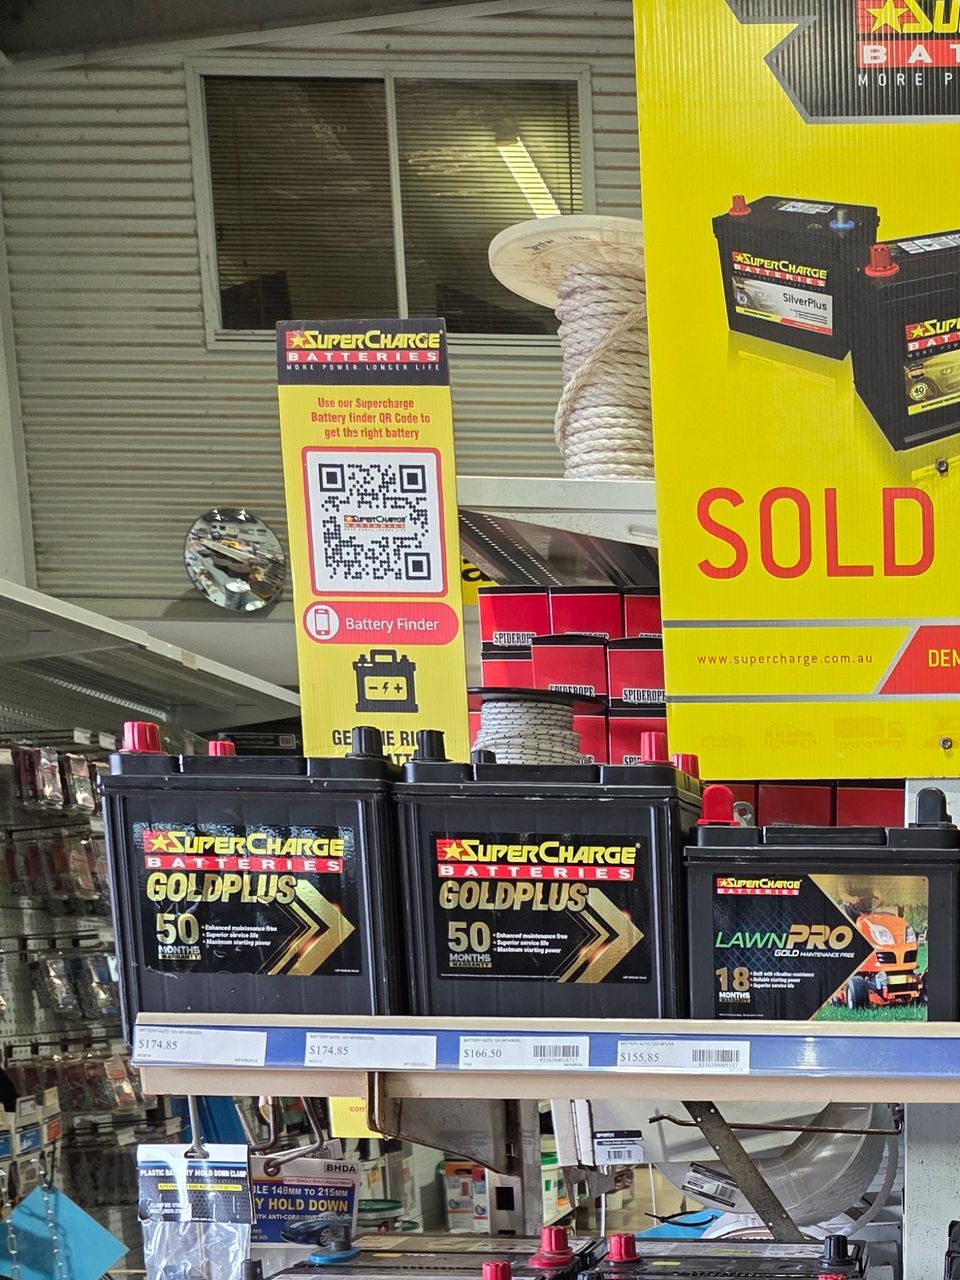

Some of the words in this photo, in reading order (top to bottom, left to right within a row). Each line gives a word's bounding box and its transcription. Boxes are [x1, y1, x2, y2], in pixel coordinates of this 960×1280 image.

[858, 71, 923, 87] MORE
[783, 292, 827, 311] SilverPlus
[303, 330, 440, 349] SUPERCHARGE
[288, 353, 437, 362] BATTERIES
[318, 398, 335, 408] Use
[339, 400, 352, 408] our
[356, 398, 414, 410] Supercharge
[312, 413, 346, 424] Battery
[379, 413, 392, 423] QR
[395, 413, 418, 423] Code
[421, 414, 430, 423] to
[325, 428, 340, 439] get
[344, 429, 358, 437] the
[361, 429, 383, 439] right
[386, 429, 419, 439] battery
[696, 486, 935, 579] SOLD
[346, 618, 393, 633] Battery
[398, 618, 439, 630] Finder
[696, 652, 874, 668] www.supercharge.com.au
[459, 840, 636, 864] SUPERCHARGE
[148, 858, 340, 871] BATTERIES
[442, 866, 631, 878] BATTERIES
[147, 872, 296, 903] GOLDPLUS
[439, 881, 588, 911] GOLDPLUS
[156, 913, 199, 944] 50
[448, 922, 490, 952] 50
[158, 945, 200, 953] MONTHS
[715, 967, 749, 991] 18
[139, 1040, 178, 1050] $174.85
[309, 1046, 348, 1055] $174.85
[464, 1050, 501, 1058] $166.50
[620, 1053, 659, 1062] $155.85
[326, 1164, 356, 1172] BHDA
[318, 1188, 348, 1196] 215MM
[269, 1199, 304, 1210] HOLD
[309, 1200, 347, 1211] DOWN
